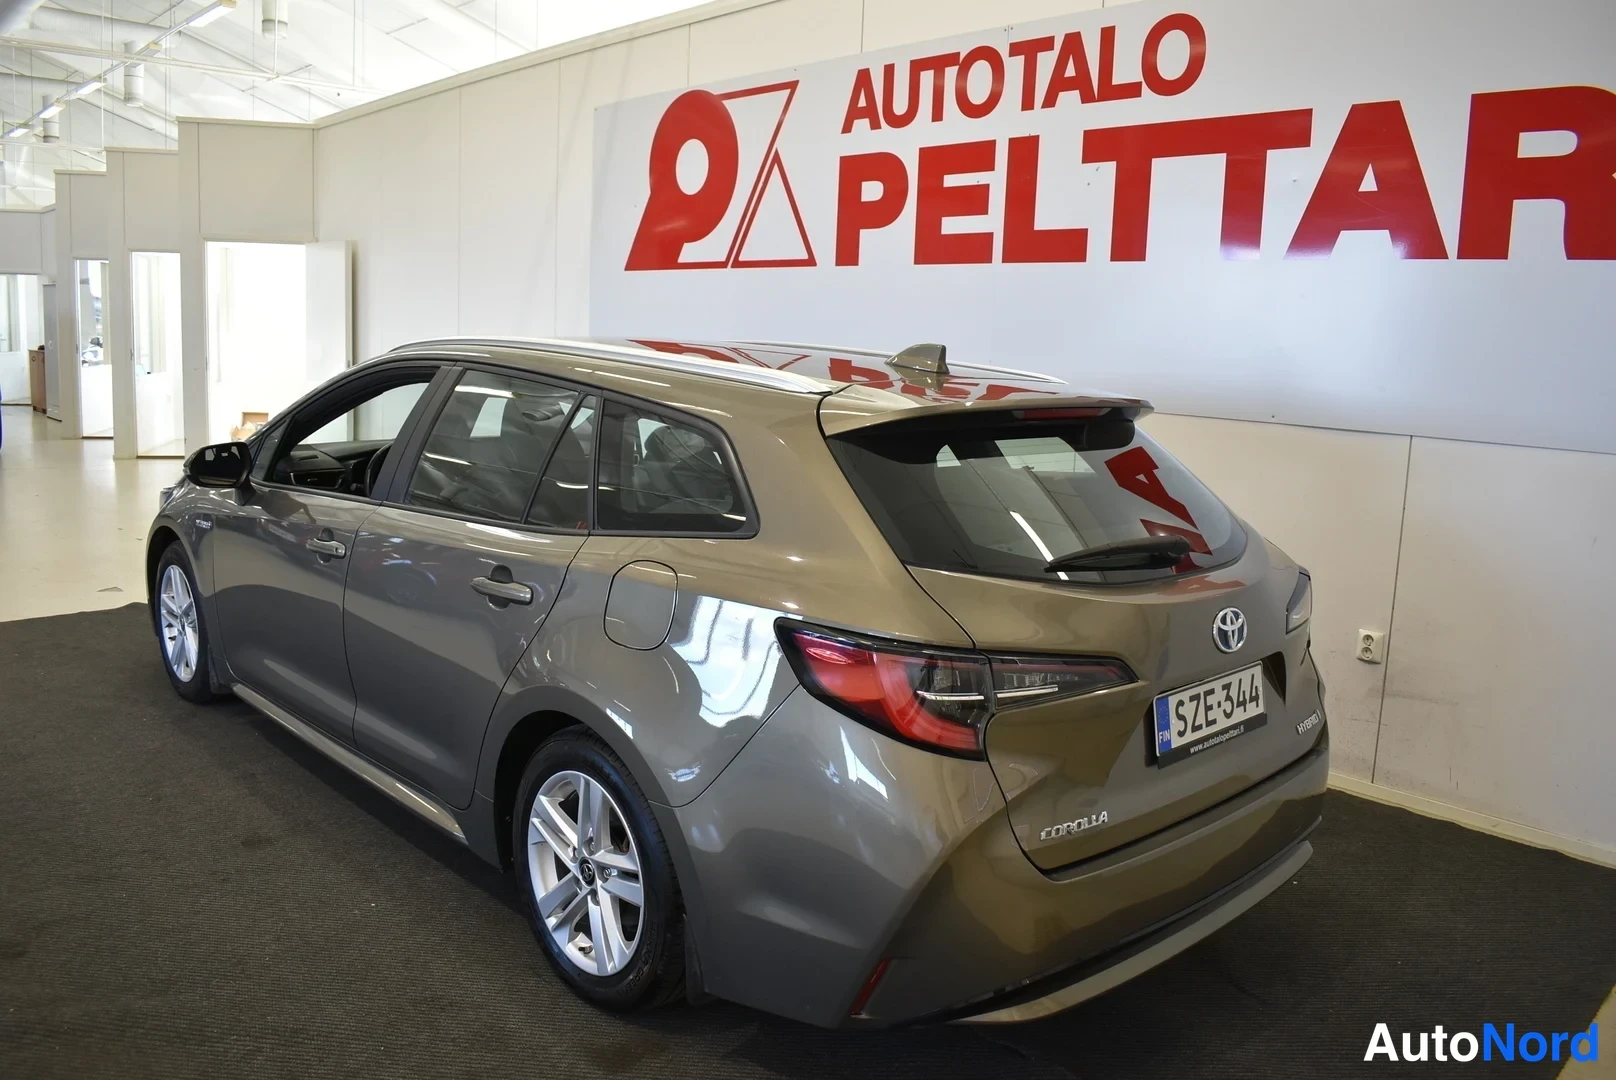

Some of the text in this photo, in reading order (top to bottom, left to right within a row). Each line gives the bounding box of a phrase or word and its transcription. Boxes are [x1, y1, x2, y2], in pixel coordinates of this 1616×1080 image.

[842, 13, 1207, 134] AUTOTALO
[1175, 673, 1260, 738] SZE-344
[1158, 729, 1171, 744] FIN
[1190, 724, 1245, 754] www.autotalopelttari.fi
[1040, 811, 1109, 841] COROLLA
